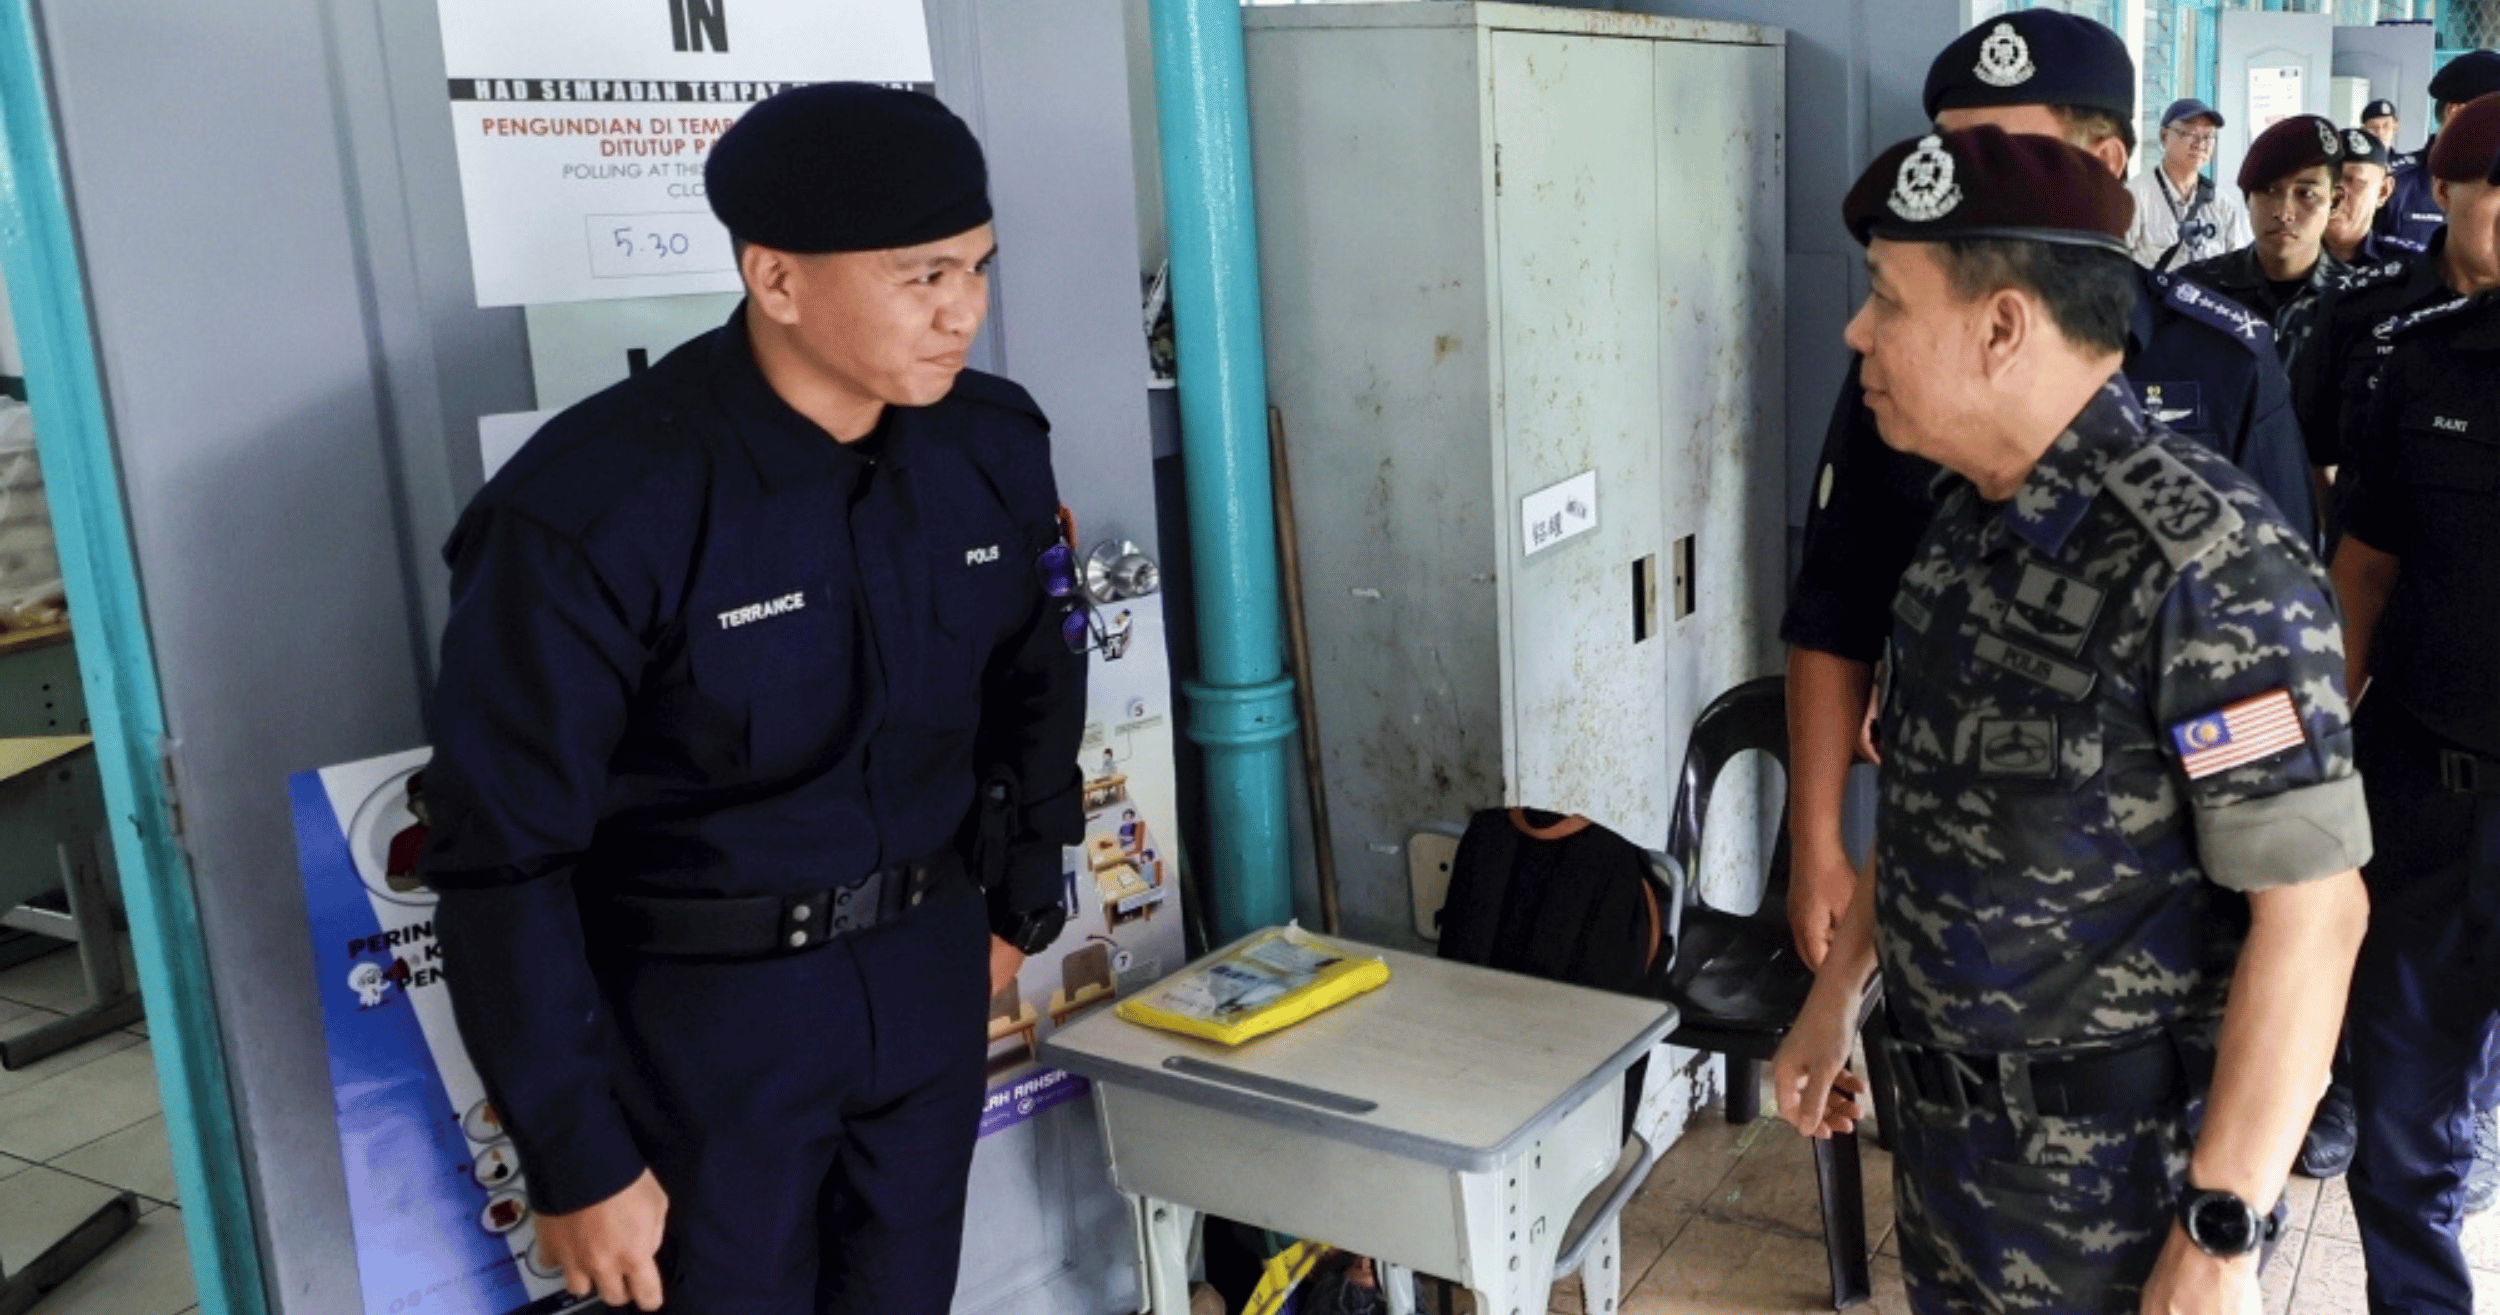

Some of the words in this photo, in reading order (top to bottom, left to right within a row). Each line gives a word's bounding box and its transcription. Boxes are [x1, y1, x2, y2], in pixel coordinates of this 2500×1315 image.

[474, 80, 528, 101] HAD
[541, 80, 678, 102] SEMPADAN
[688, 81, 780, 102] TEMPAT
[482, 118, 642, 136] PENGUNDIAN
[650, 118, 673, 135] DI
[600, 138, 686, 158] DITUTUP
[562, 163, 642, 180] POLLING
[648, 163, 669, 178] AT
[966, 545, 999, 567] POLIS
[717, 591, 806, 631] TERRANCE
